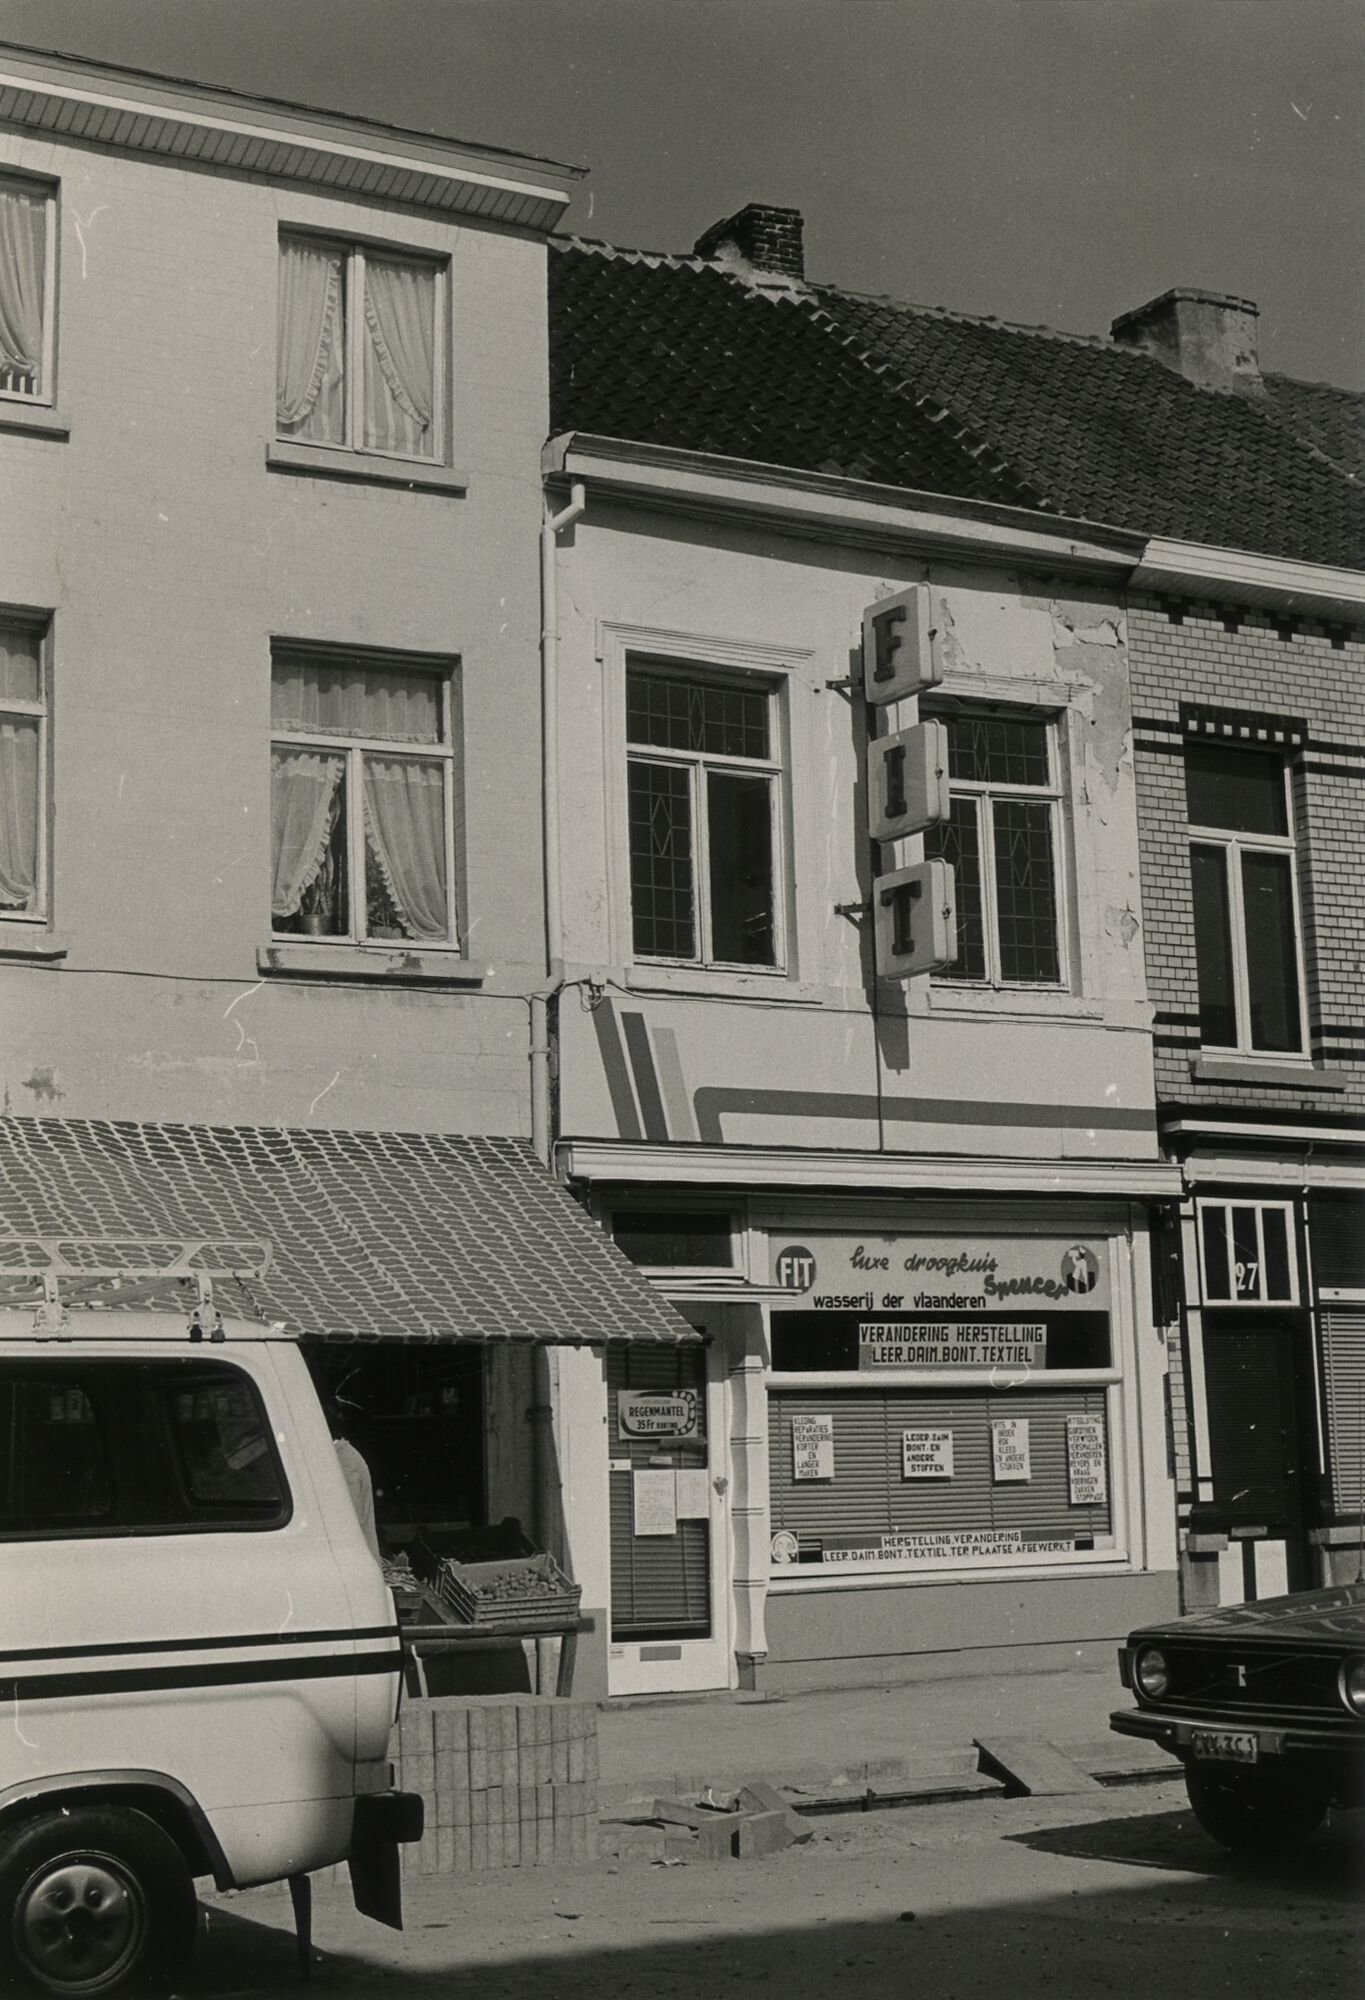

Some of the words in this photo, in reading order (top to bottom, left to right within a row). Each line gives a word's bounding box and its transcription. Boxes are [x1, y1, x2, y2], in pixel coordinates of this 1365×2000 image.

[872, 605, 921, 956] FIT
[781, 1257, 813, 1287] FIT
[850, 1245, 889, 1270] luxe
[904, 1253, 998, 1277] droogkuis
[984, 1274, 1069, 1301] Spencer
[1235, 1262, 1258, 1291] 27
[814, 1292, 873, 1311] wasserij
[882, 1293, 904, 1308] der
[914, 1292, 986, 1308] vlaanderen
[861, 1326, 949, 1342] VERANDERING
[957, 1326, 1042, 1342] HERSTELLING
[629, 1406, 684, 1417] REGENMANTEL
[911, 1464, 944, 1472] STOFFEN
[973, 1544, 1012, 1556] PLAATSE
[1016, 1541, 1071, 1553] AFGEWERKT
